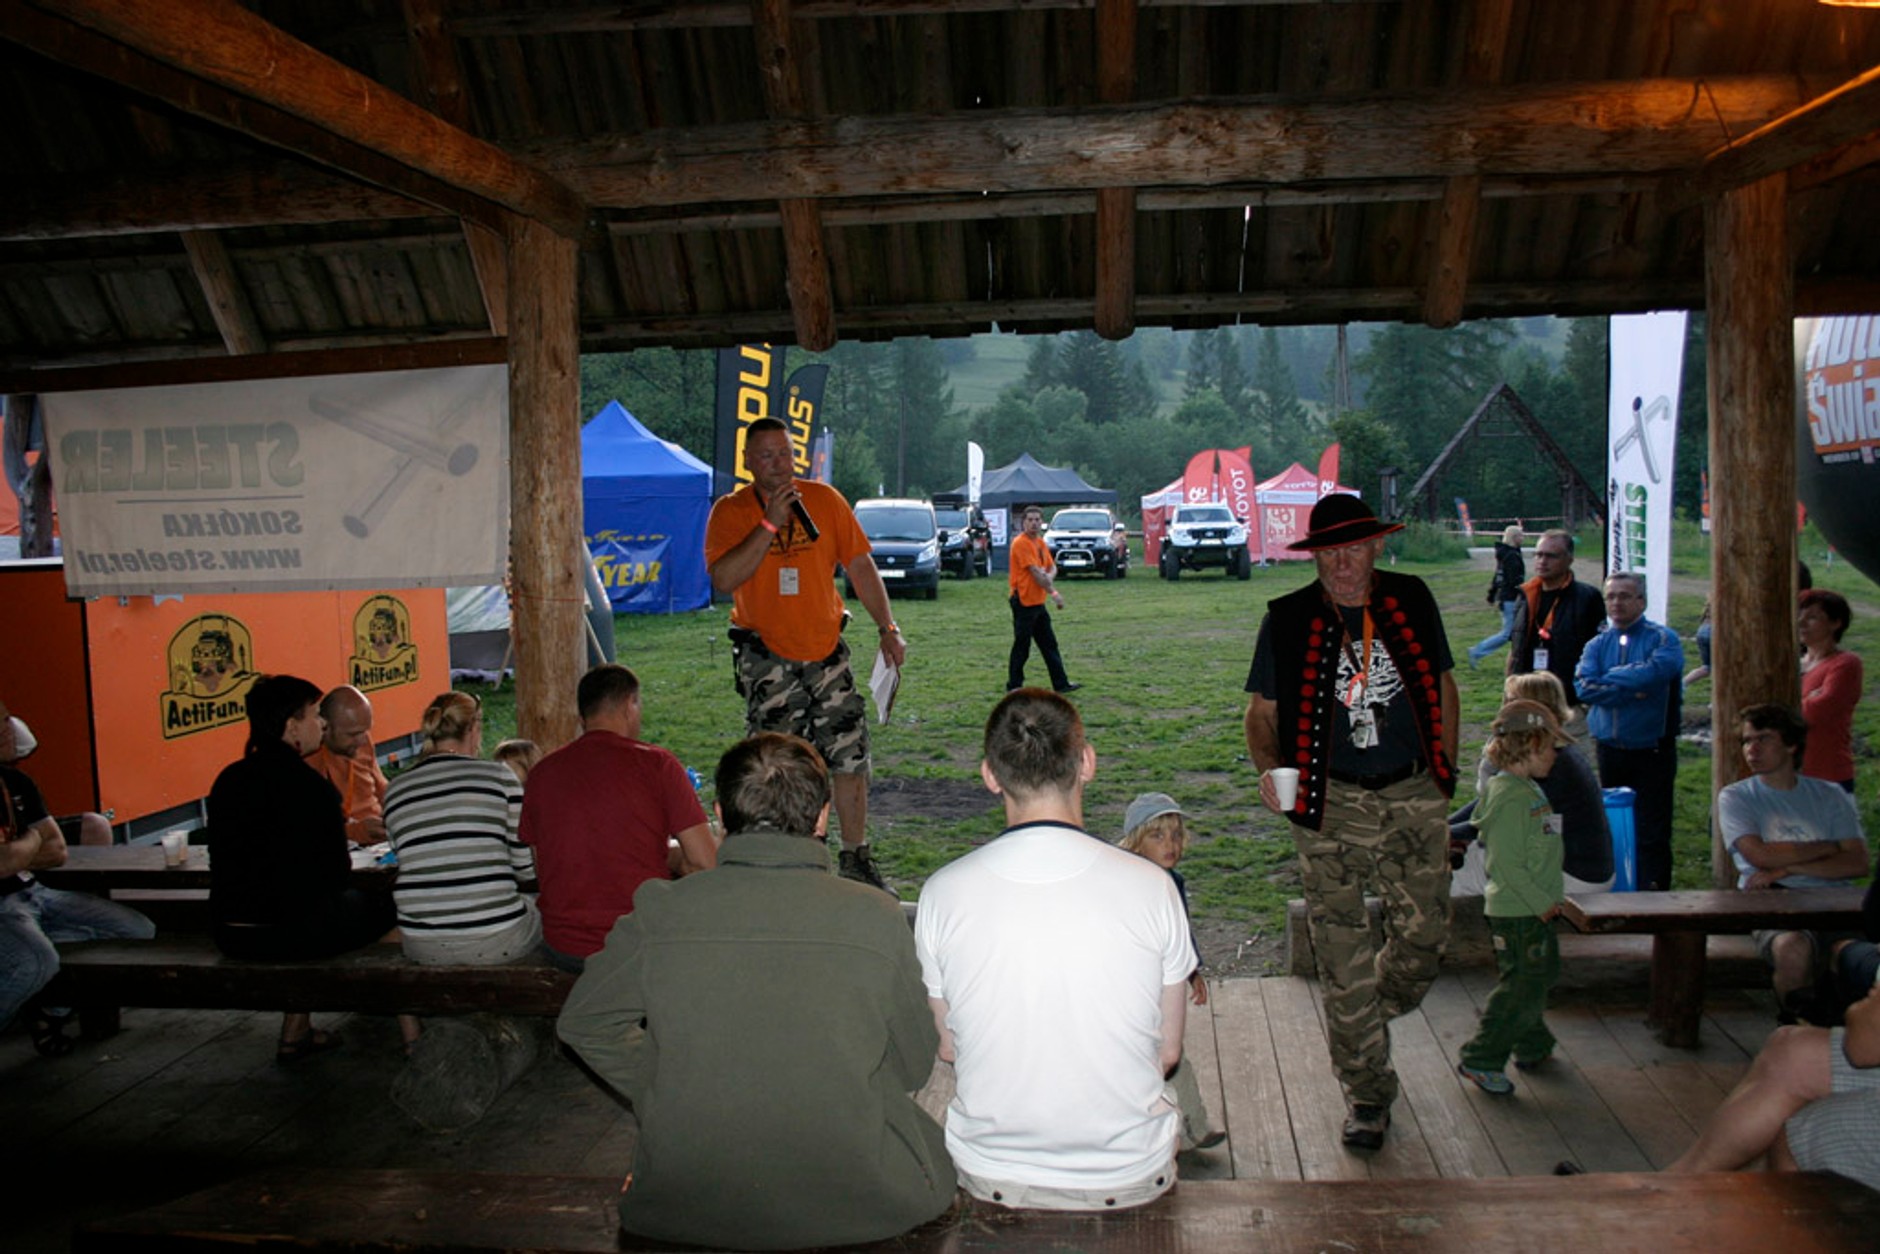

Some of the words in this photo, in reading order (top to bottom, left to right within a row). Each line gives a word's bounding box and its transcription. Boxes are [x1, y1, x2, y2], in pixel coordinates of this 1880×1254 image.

[1808, 365, 1880, 447] Świa
[1624, 483, 1648, 572] STEEL
[602, 561, 662, 588] YEAR
[353, 653, 418, 687] ActiFun.pl
[168, 699, 245, 730] ActiFun.
